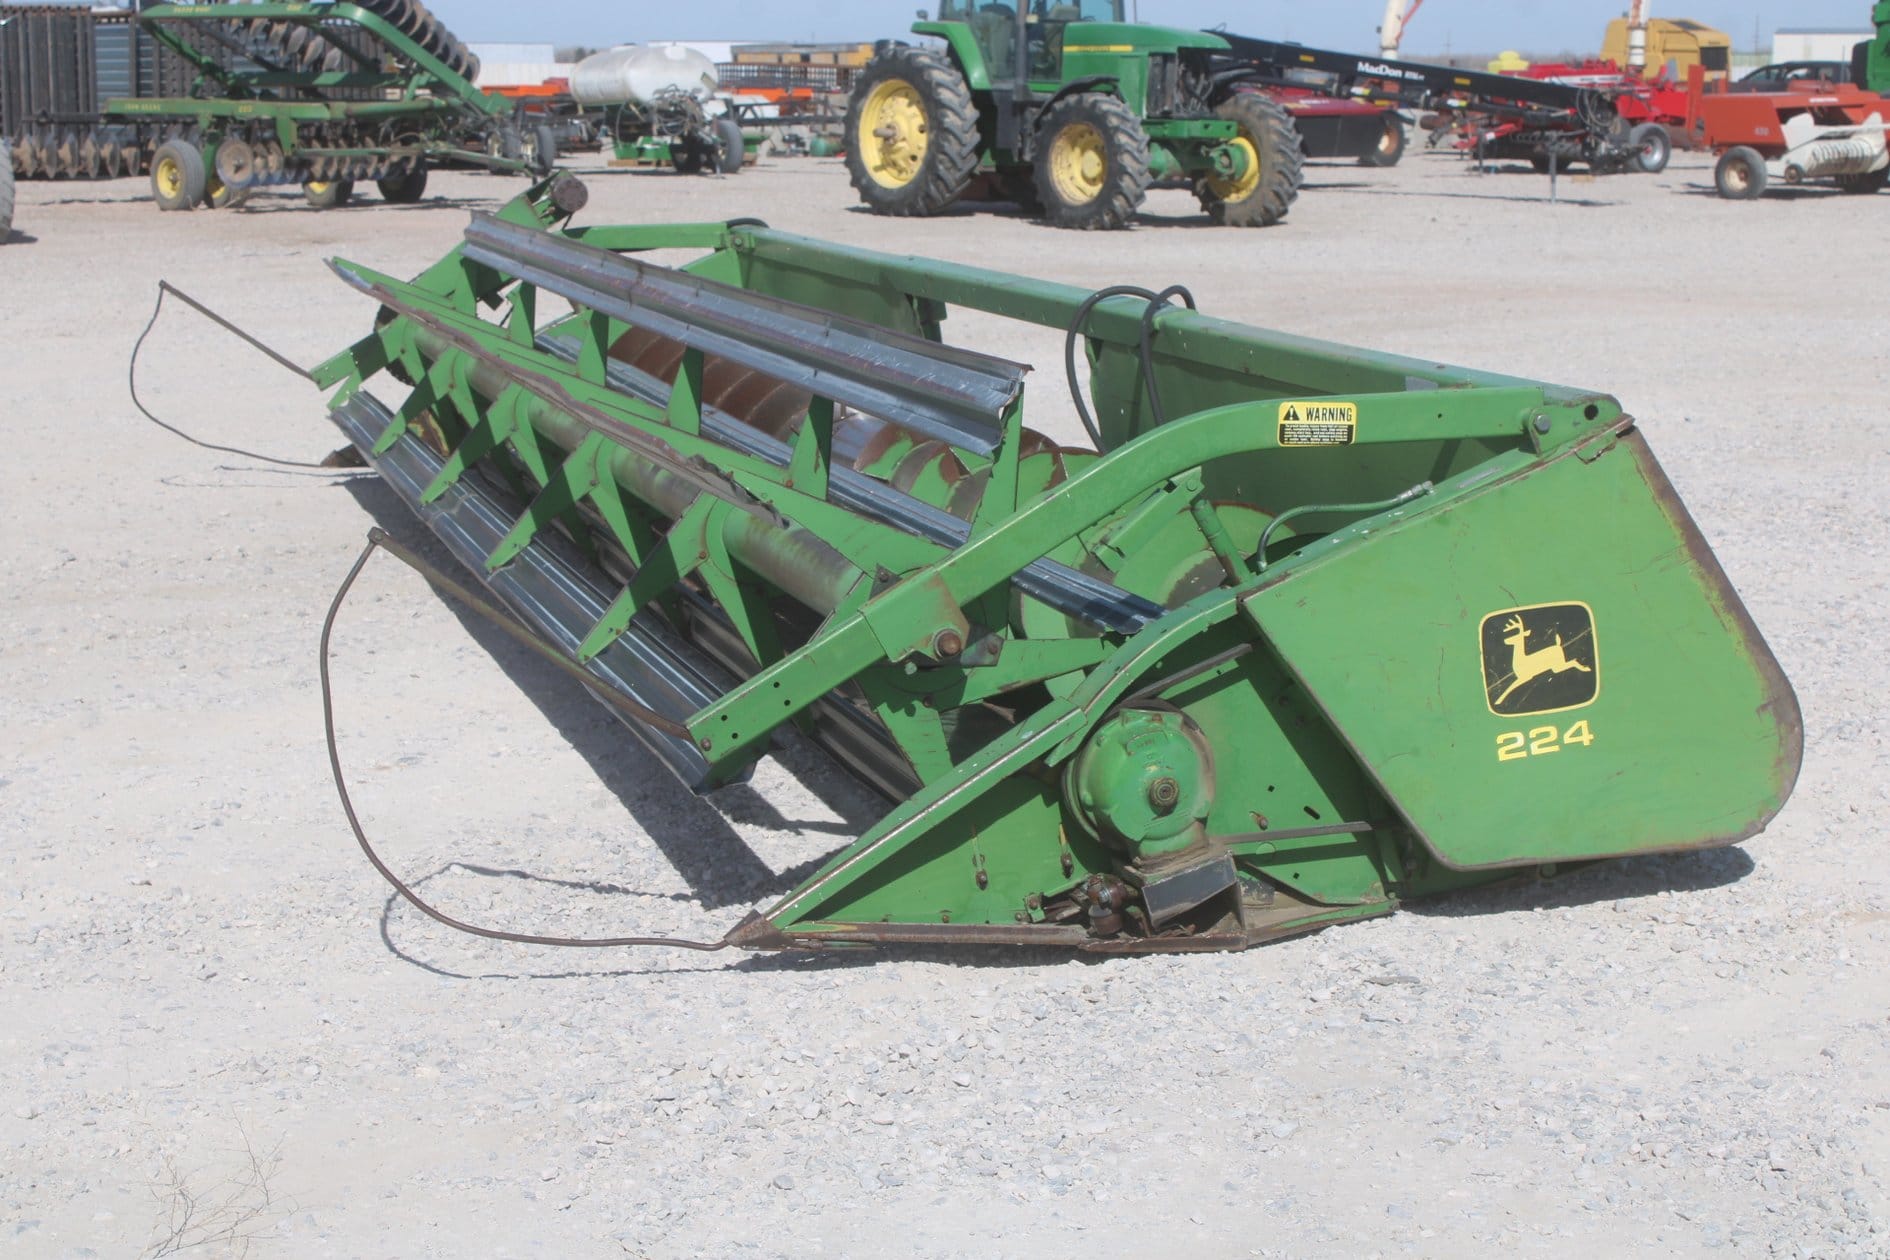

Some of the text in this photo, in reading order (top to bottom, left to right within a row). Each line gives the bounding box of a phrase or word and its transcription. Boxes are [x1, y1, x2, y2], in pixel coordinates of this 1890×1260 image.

[1357, 61, 1403, 78] MacDon
[1306, 407, 1353, 421] WARNING
[1496, 719, 1594, 762] 224
